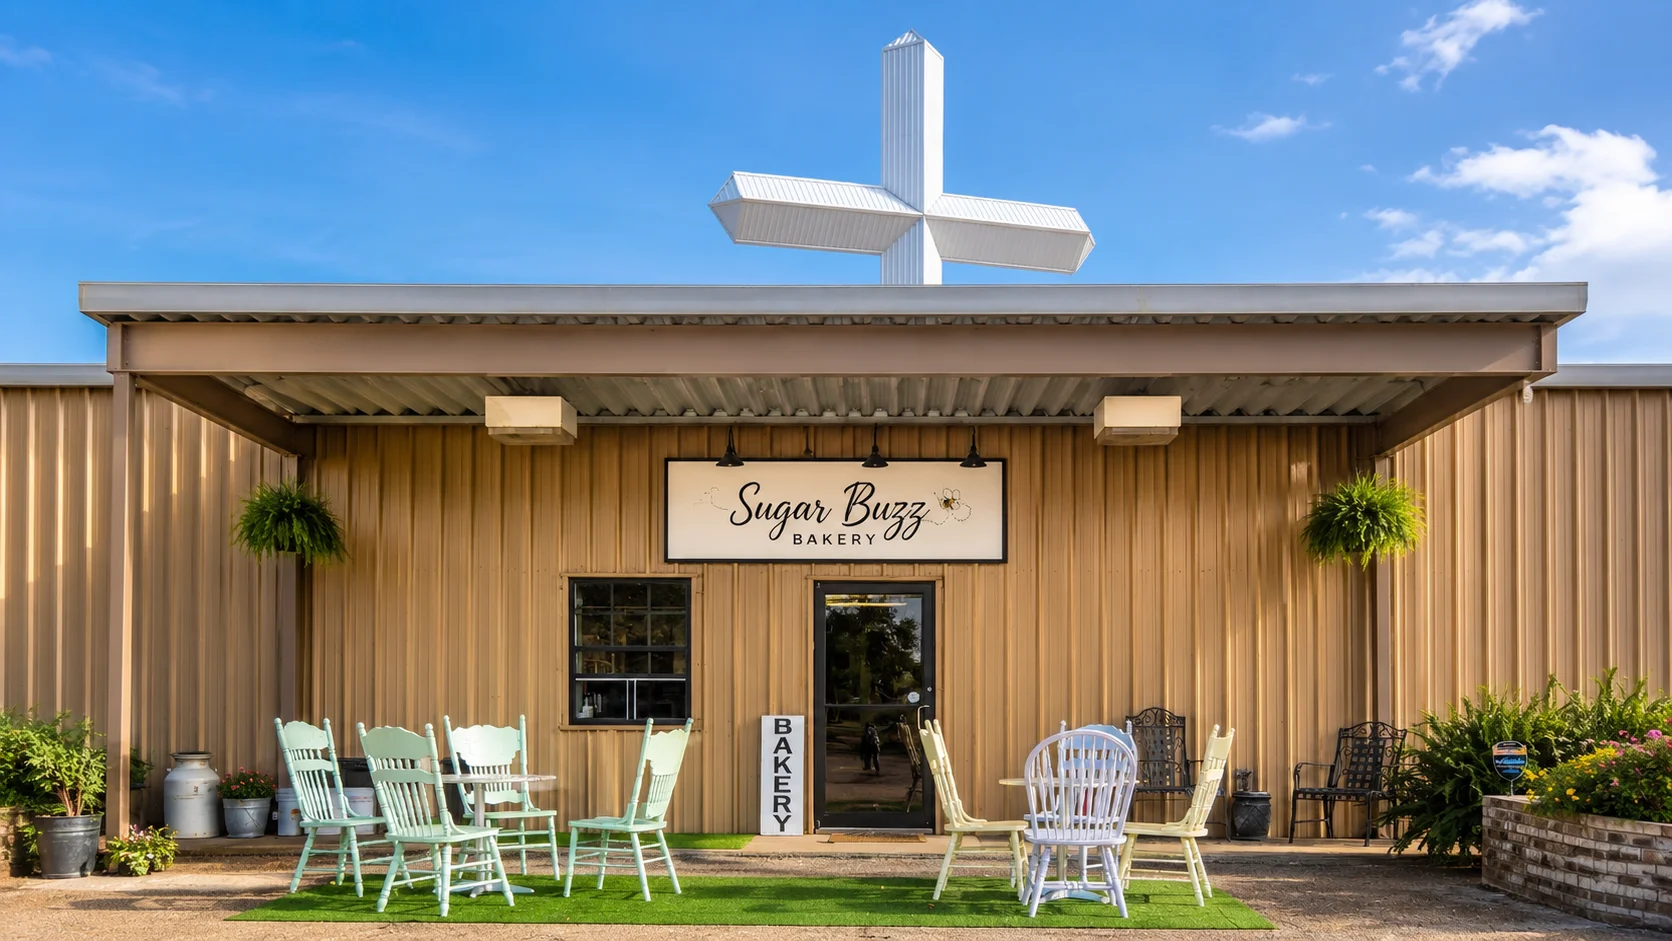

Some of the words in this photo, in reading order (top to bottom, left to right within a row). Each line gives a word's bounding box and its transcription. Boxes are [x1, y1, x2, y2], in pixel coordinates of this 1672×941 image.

[729, 481, 833, 541] Sugar
[841, 481, 931, 541] Buzz
[792, 533, 876, 546] BAKERY
[773, 718, 793, 832] BAKERY
